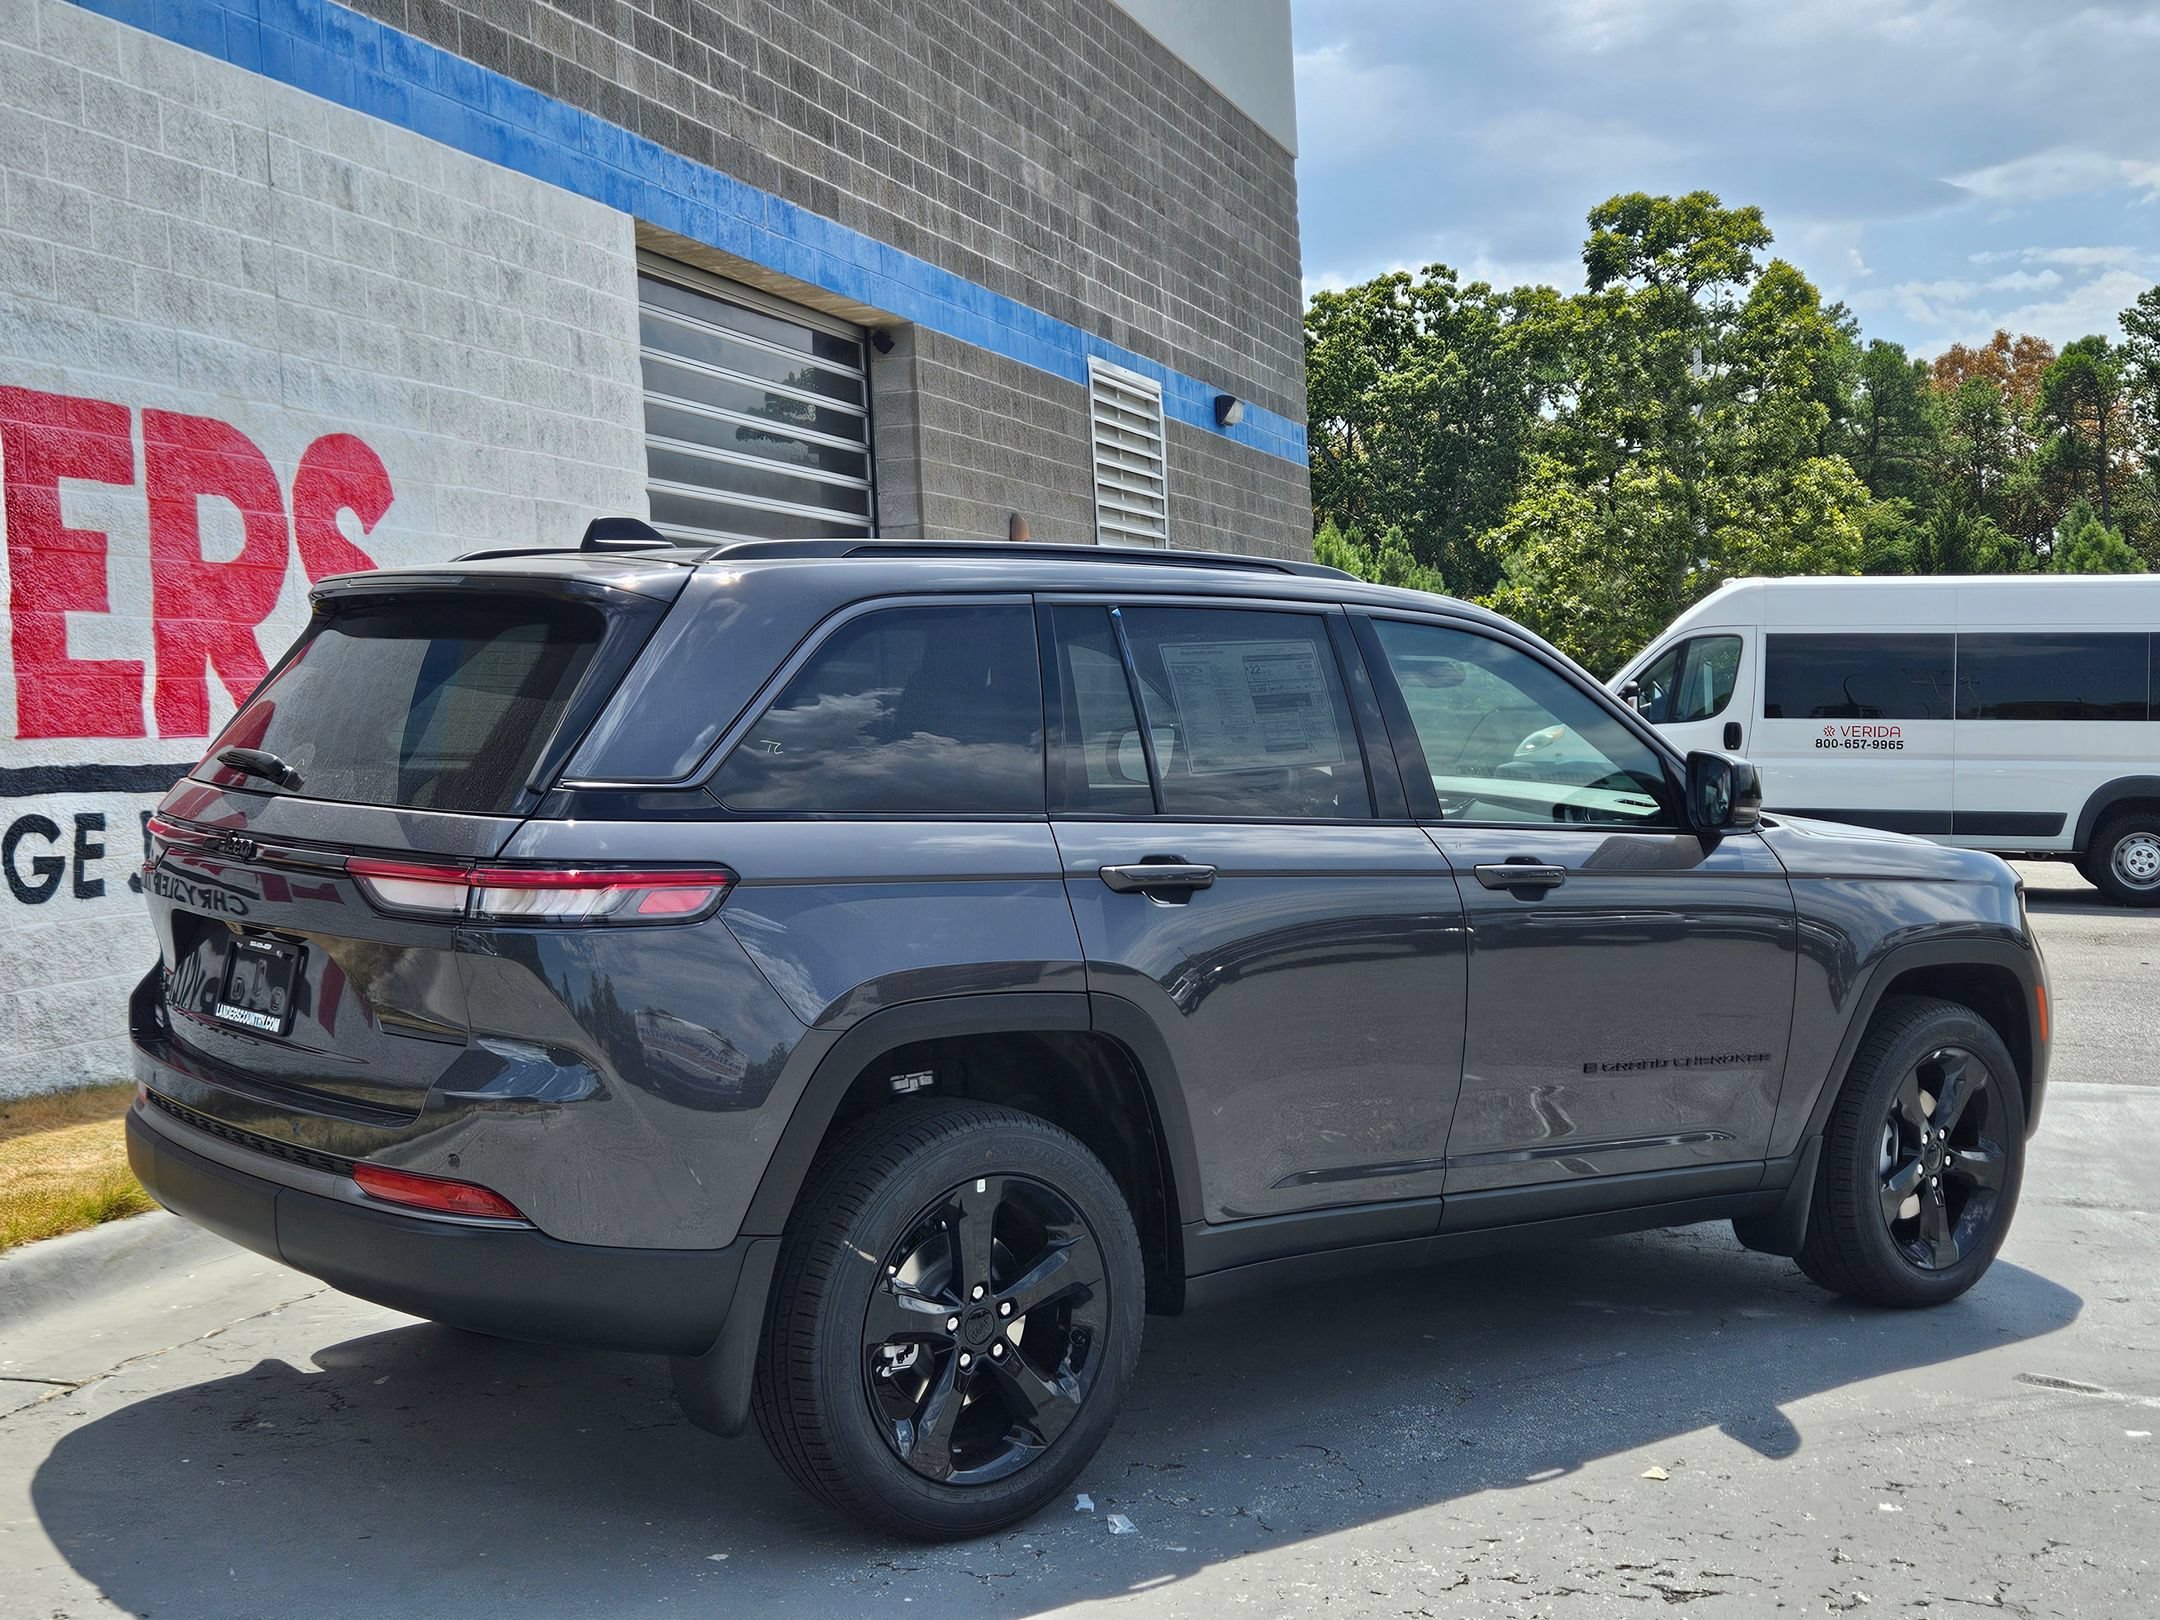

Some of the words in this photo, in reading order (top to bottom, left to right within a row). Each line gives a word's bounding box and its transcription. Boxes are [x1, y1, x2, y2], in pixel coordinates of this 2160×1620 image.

[1840, 725, 1901, 738] VERIDA
[1815, 738, 1904, 750] 800-657-9965
[2, 813, 106, 904] GE
